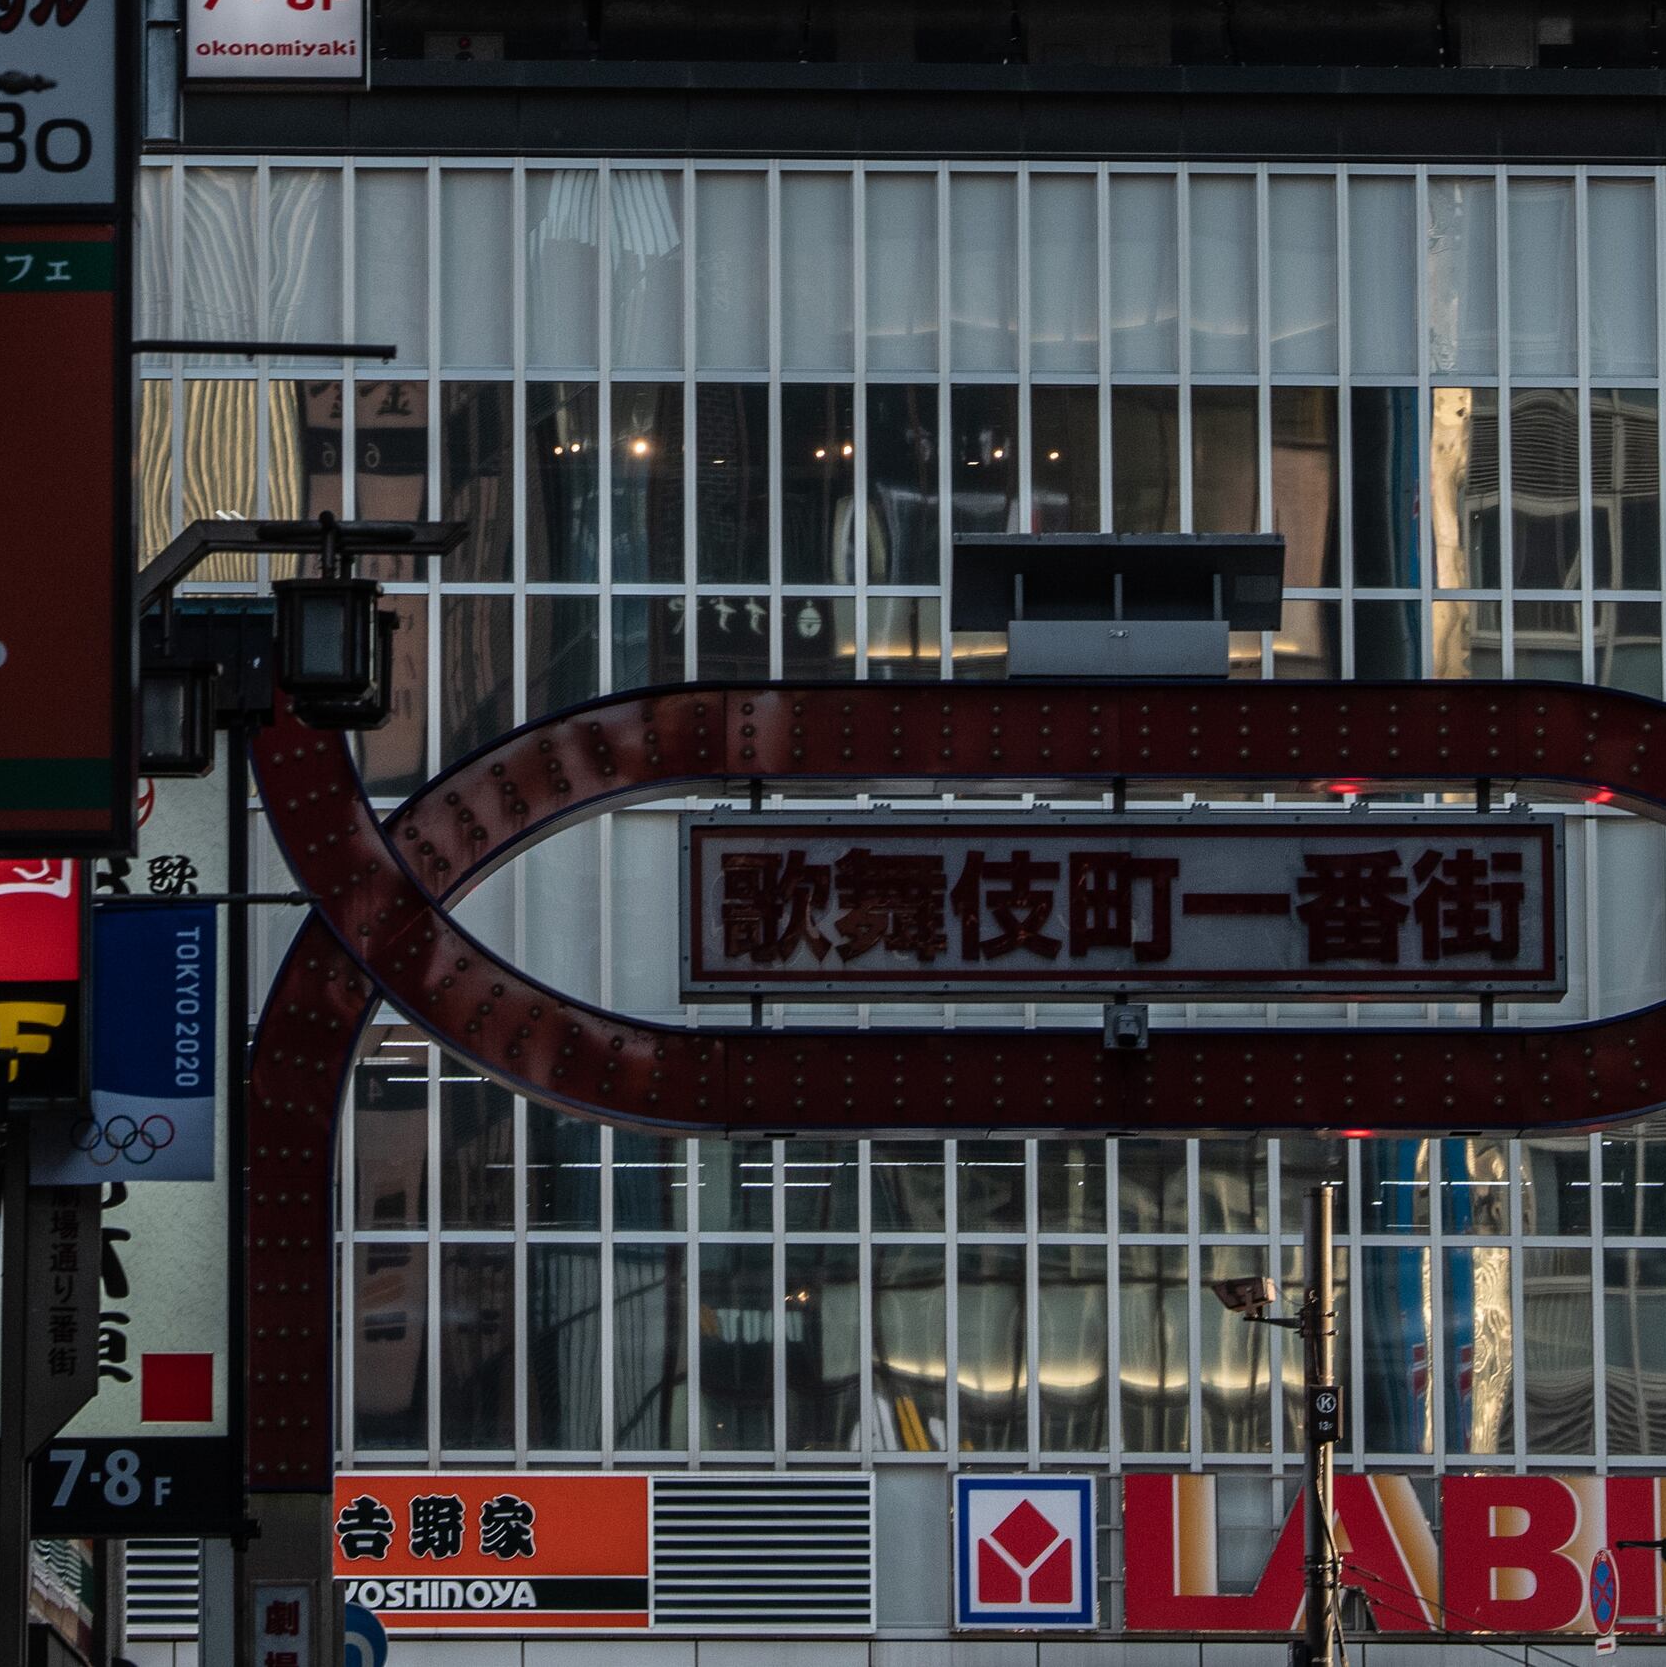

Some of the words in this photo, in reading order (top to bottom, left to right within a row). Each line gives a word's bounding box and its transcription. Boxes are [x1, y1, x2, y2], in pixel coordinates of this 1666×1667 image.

[195, 39, 358, 59] okonomiyaki
[719, 847, 1525, 965] 歌舞伎町一番街
[173, 924, 203, 1017] TOKYO
[173, 1021, 203, 1089] 2020
[335, 1494, 537, 1562] 吉野家
